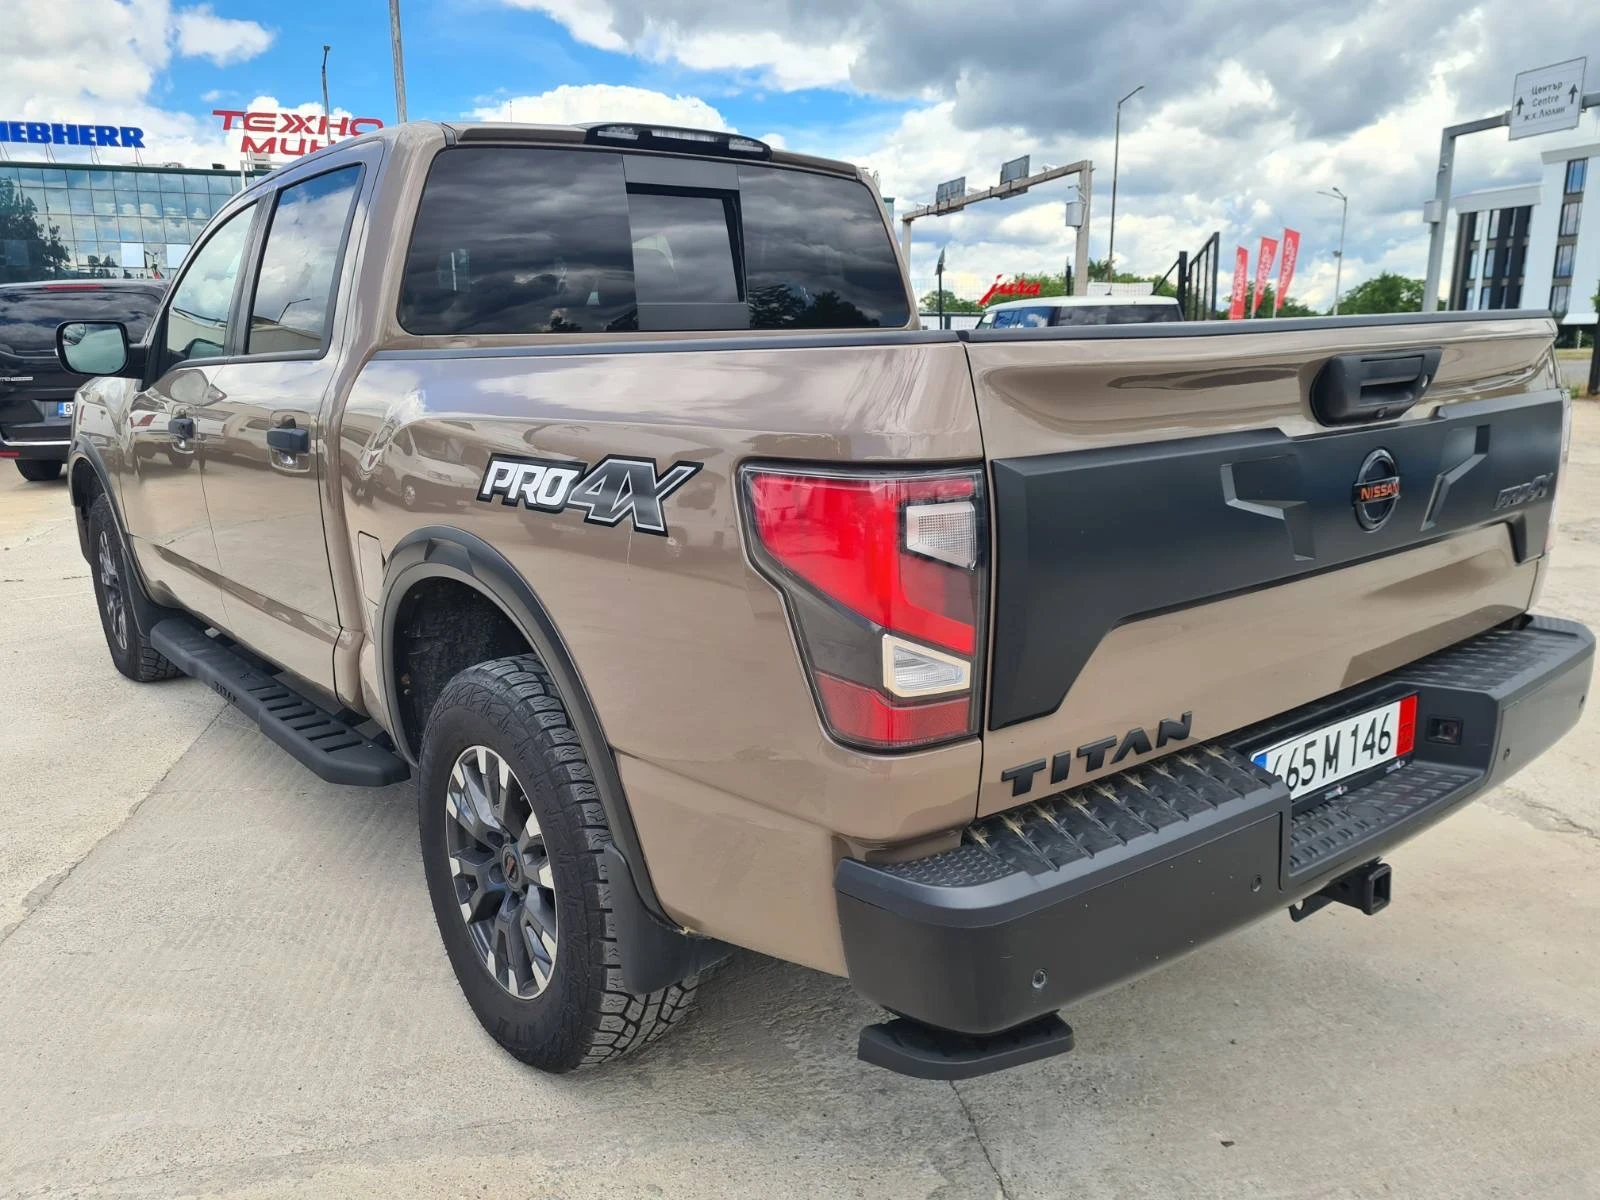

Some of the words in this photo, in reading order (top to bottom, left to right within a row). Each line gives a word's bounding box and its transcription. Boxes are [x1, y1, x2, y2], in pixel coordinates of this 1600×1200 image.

[1532, 82, 1562, 95] Център
[1532, 95, 1559, 107] Centre
[0, 120, 146, 149] IEBHERR
[1360, 481, 1400, 501] NISSAN
[1001, 711, 1193, 798] TITAN
[1322, 729, 1342, 779] M
[1350, 711, 1392, 768] 146
